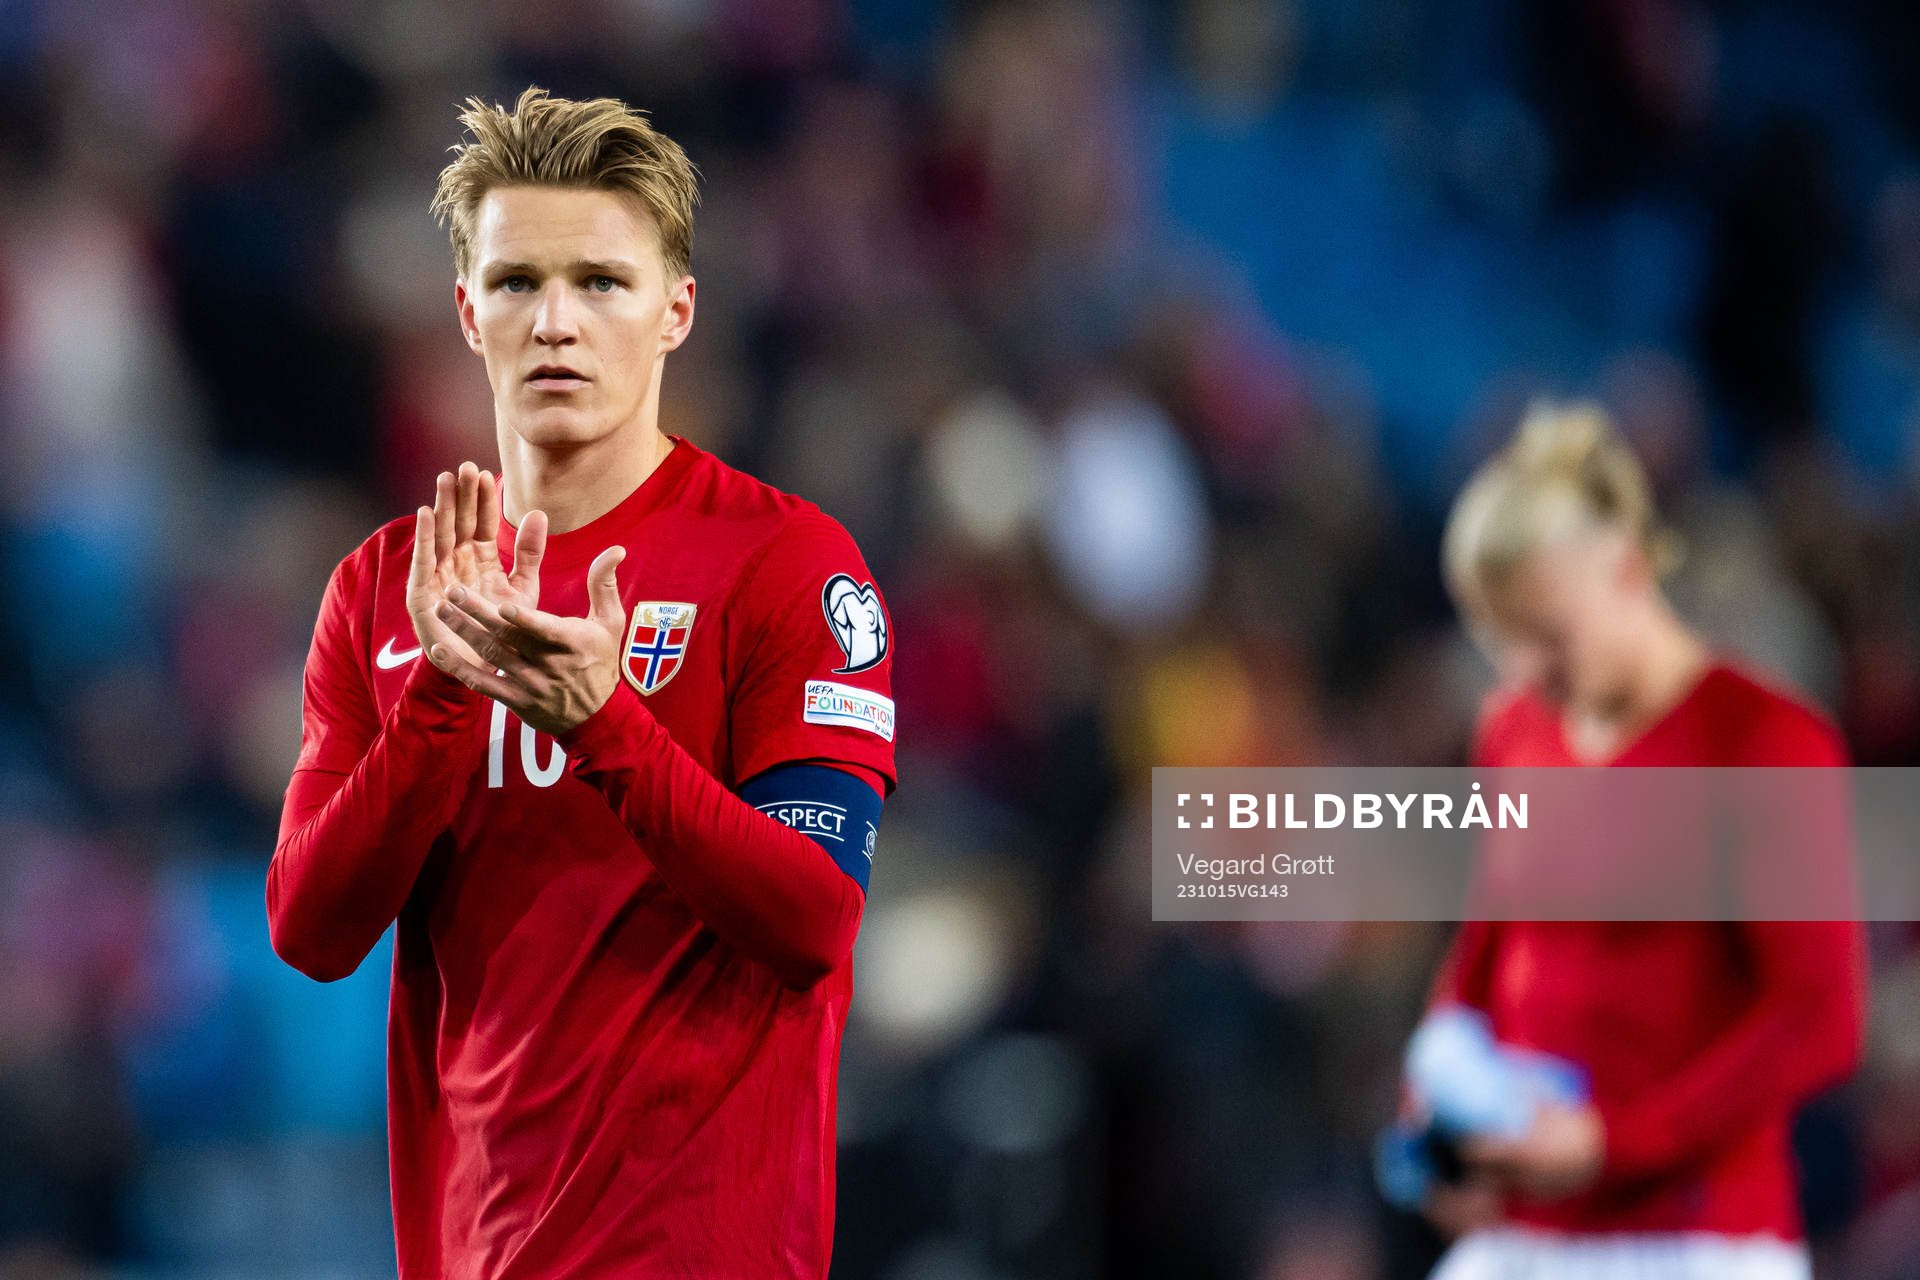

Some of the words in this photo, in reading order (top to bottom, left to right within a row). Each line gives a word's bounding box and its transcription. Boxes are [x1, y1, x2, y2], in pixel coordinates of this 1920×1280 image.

[658, 606, 679, 614] NORGE
[807, 684, 834, 695] UEFA
[807, 695, 893, 728] FOUNDATION
[488, 700, 567, 788] 10
